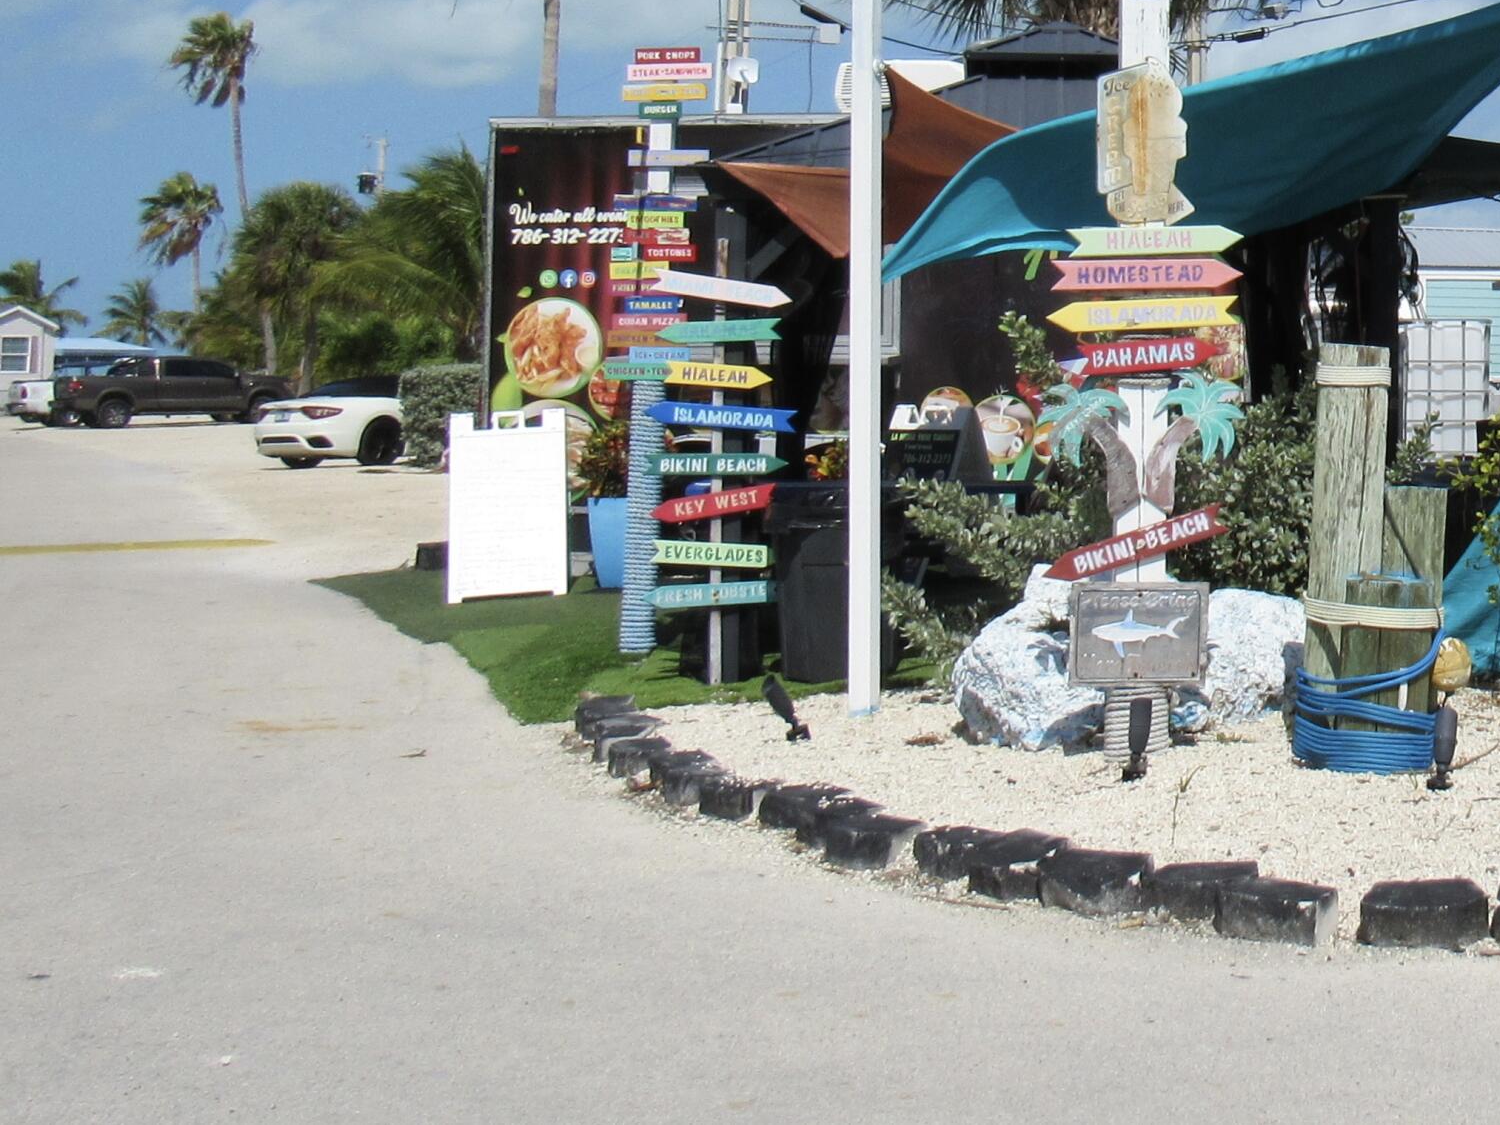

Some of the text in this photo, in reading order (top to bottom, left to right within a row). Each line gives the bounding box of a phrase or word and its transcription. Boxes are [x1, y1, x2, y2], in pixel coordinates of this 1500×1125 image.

[637, 51, 695, 60] PORK CHOPS
[1103, 79, 1131, 97] Ice
[644, 105, 678, 114] BURGER
[509, 201, 537, 225] We
[539, 209, 571, 223] cater
[574, 206, 595, 222] all
[1106, 230, 1193, 250] HIALEAH
[647, 248, 692, 257] TOSTONES
[1077, 265, 1204, 284] HOMESTEAD
[629, 301, 672, 309] TAMALES
[618, 317, 648, 325] CUBAN
[1087, 305, 1218, 326] ISLAMORADA
[1092, 343, 1196, 368] BAHAMAS
[682, 366, 749, 385] HIALEAH
[673, 406, 774, 428] ISLAMORADA
[660, 457, 767, 473] BIKINI BEACH
[673, 489, 759, 517] KEY WEST
[1073, 512, 1210, 574] BIKINI BEACH
[664, 544, 765, 564] EVERGLADES
[656, 587, 703, 604] FRESH
